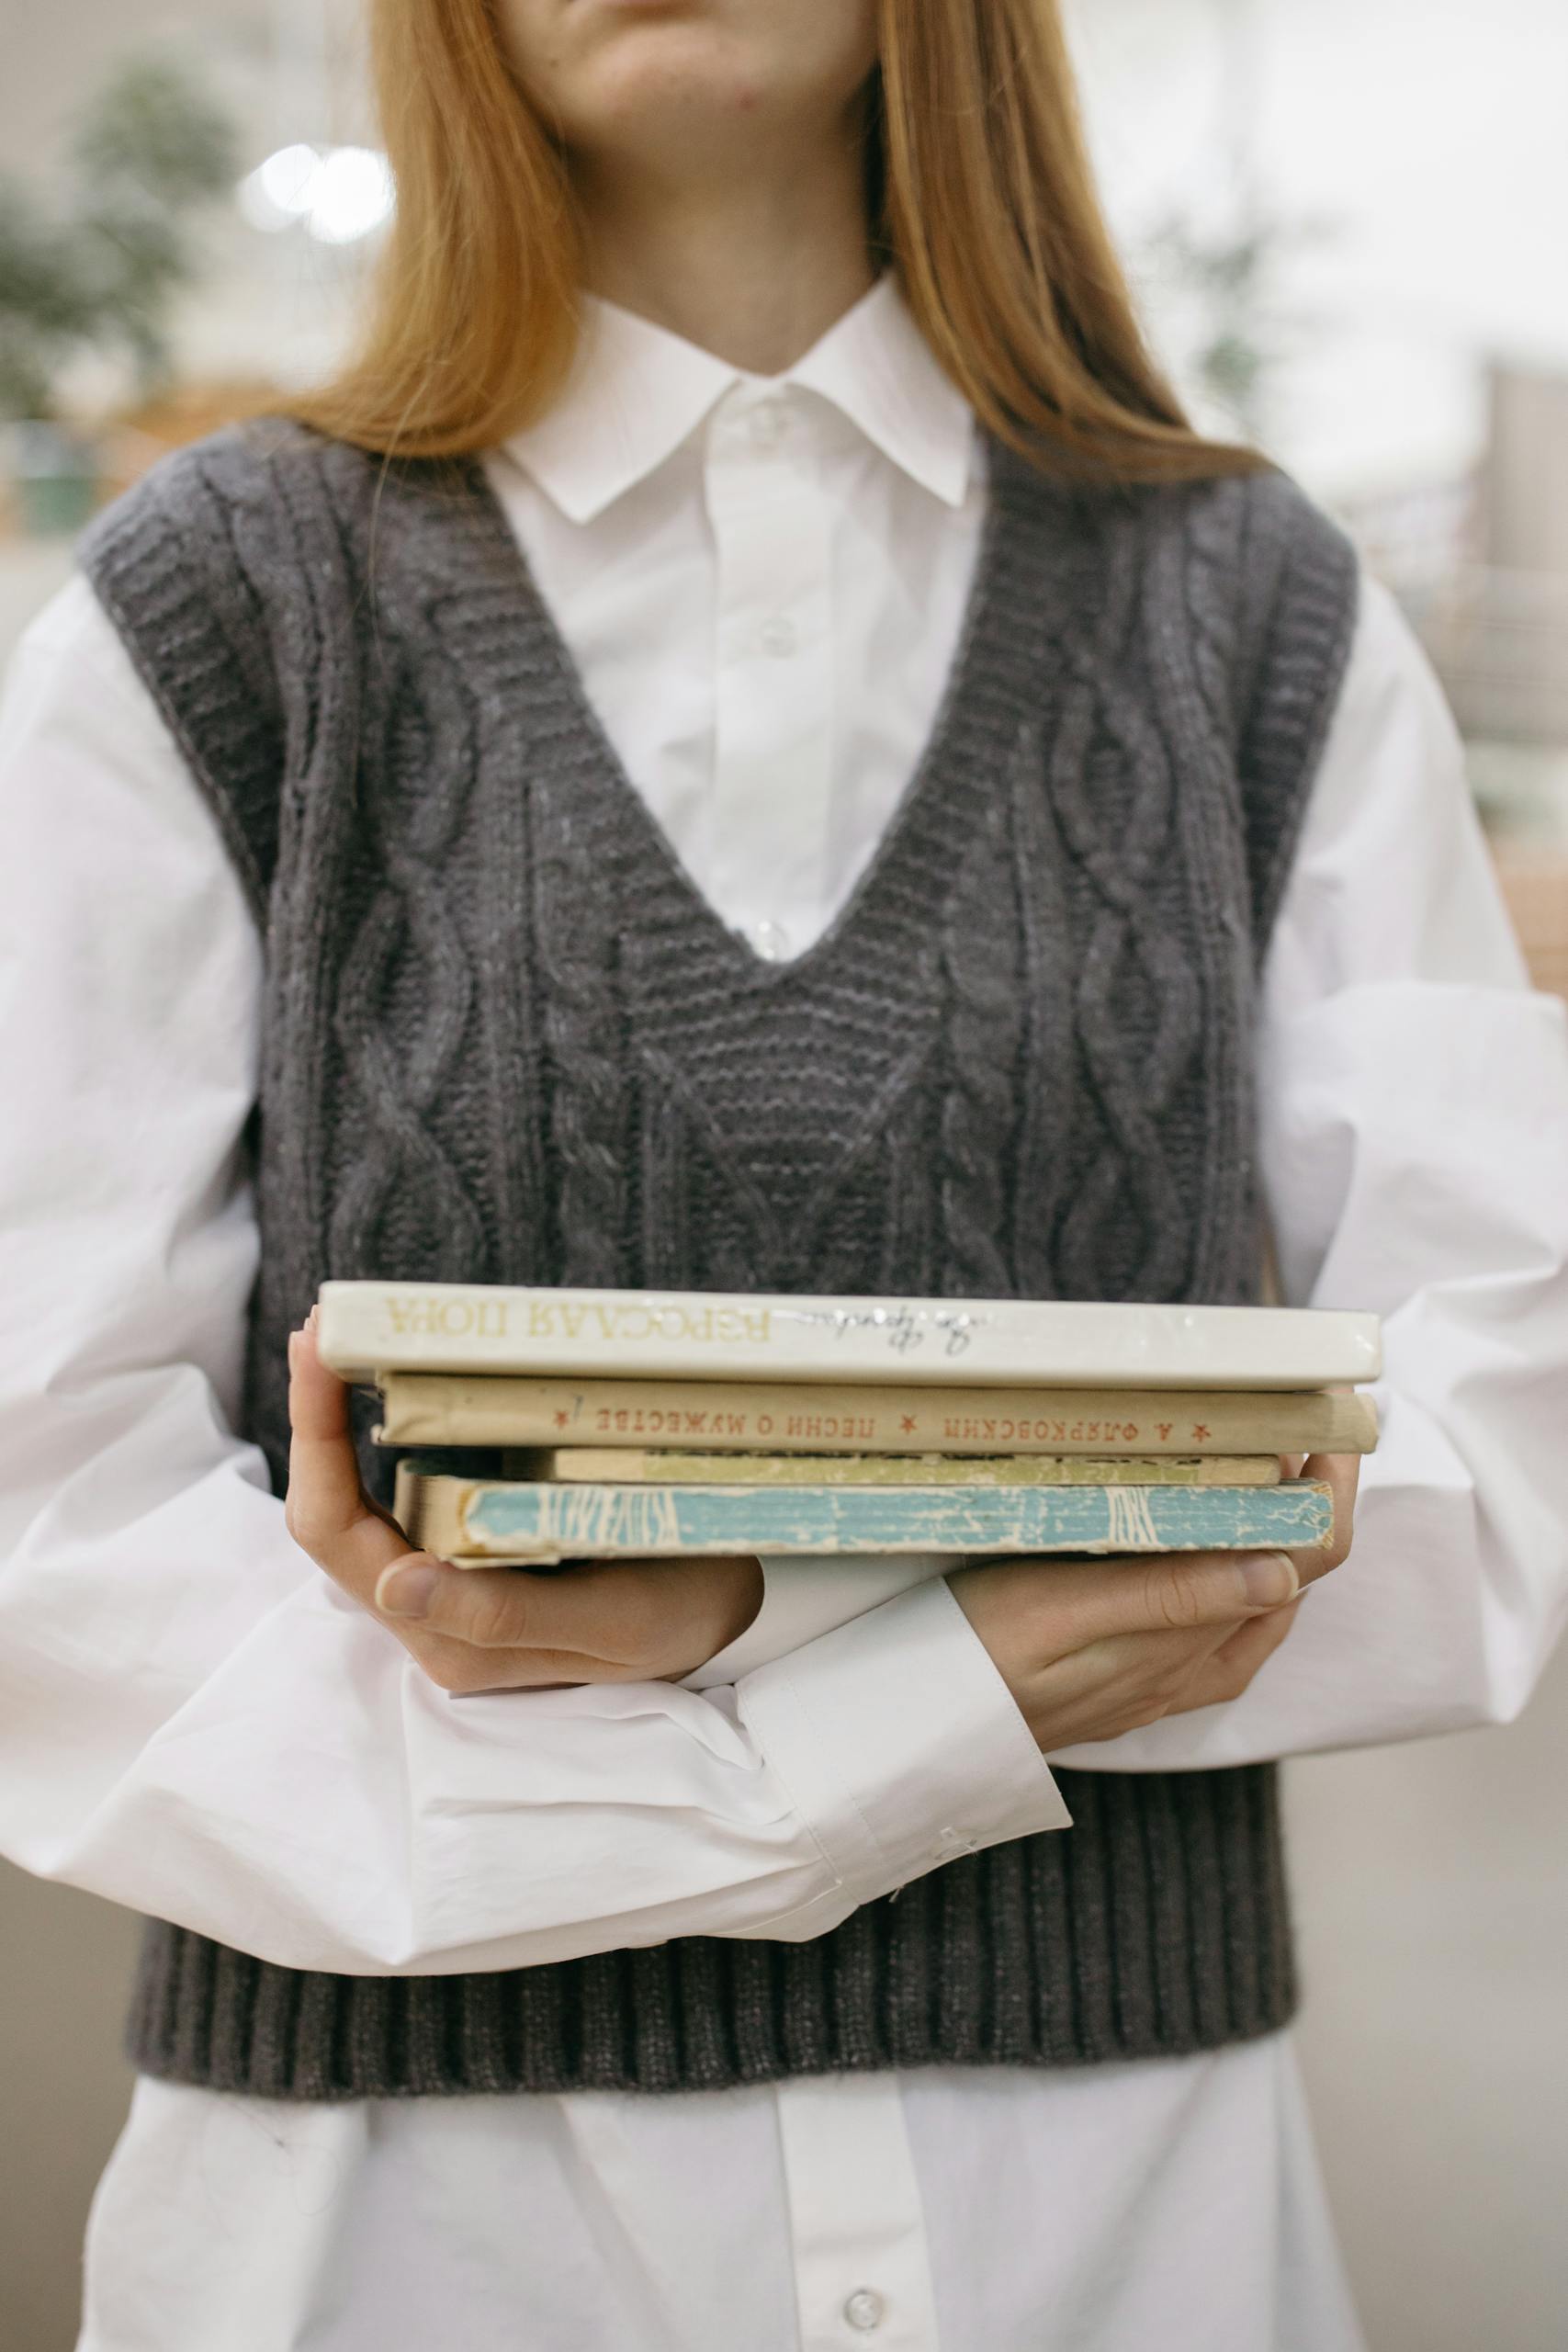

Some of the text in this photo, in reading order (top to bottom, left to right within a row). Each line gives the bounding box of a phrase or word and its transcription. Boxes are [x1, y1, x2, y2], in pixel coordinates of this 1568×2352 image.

[385, 1296, 772, 1342] ВЗРОСЛАЯ ПОРА
[596, 1408, 875, 1439] ПЕСНИ О МУЖЕСТВЕ
